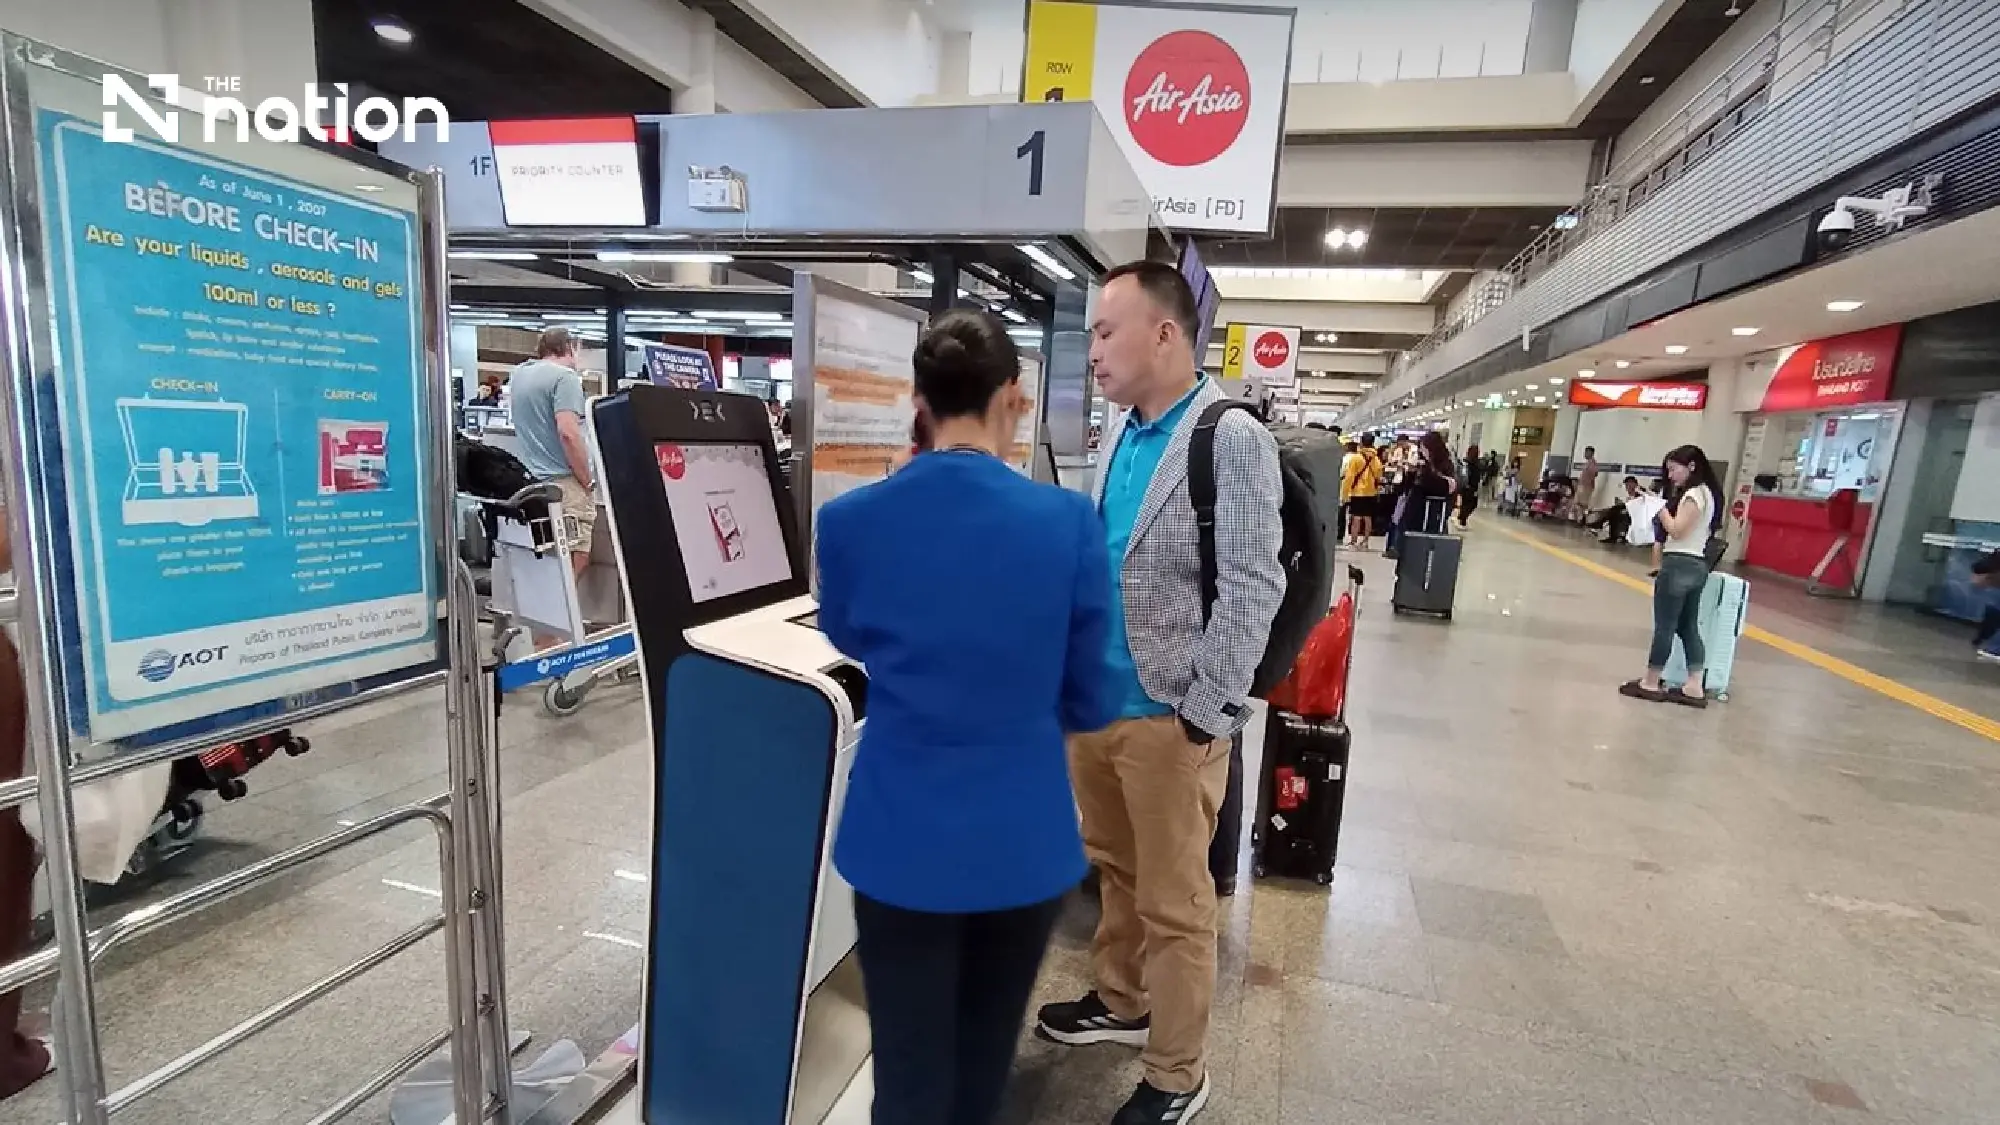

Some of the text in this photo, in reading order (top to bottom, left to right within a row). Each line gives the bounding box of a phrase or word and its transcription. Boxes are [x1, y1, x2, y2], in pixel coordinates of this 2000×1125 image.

[1045, 61, 1074, 75] ROW
[1132, 71, 1244, 126] AirAsia
[468, 154, 492, 177] 1F
[1016, 130, 1046, 196] 1
[199, 174, 217, 190] As
[222, 181, 237, 195] of
[242, 185, 272, 204] June
[1151, 195, 1196, 215] irAsia
[124, 181, 379, 263] BEFORE CHECK-IN
[86, 224, 125, 247] Are
[134, 236, 184, 258] your
[189, 241, 250, 270] liquids
[270, 262, 337, 286] aerosols
[341, 275, 370, 292] and
[374, 280, 403, 299] gels
[202, 282, 337, 319] 100ml or less ?
[1228, 344, 1241, 366] 2
[1242, 383, 1253, 398] 2
[177, 644, 229, 669] AOT
